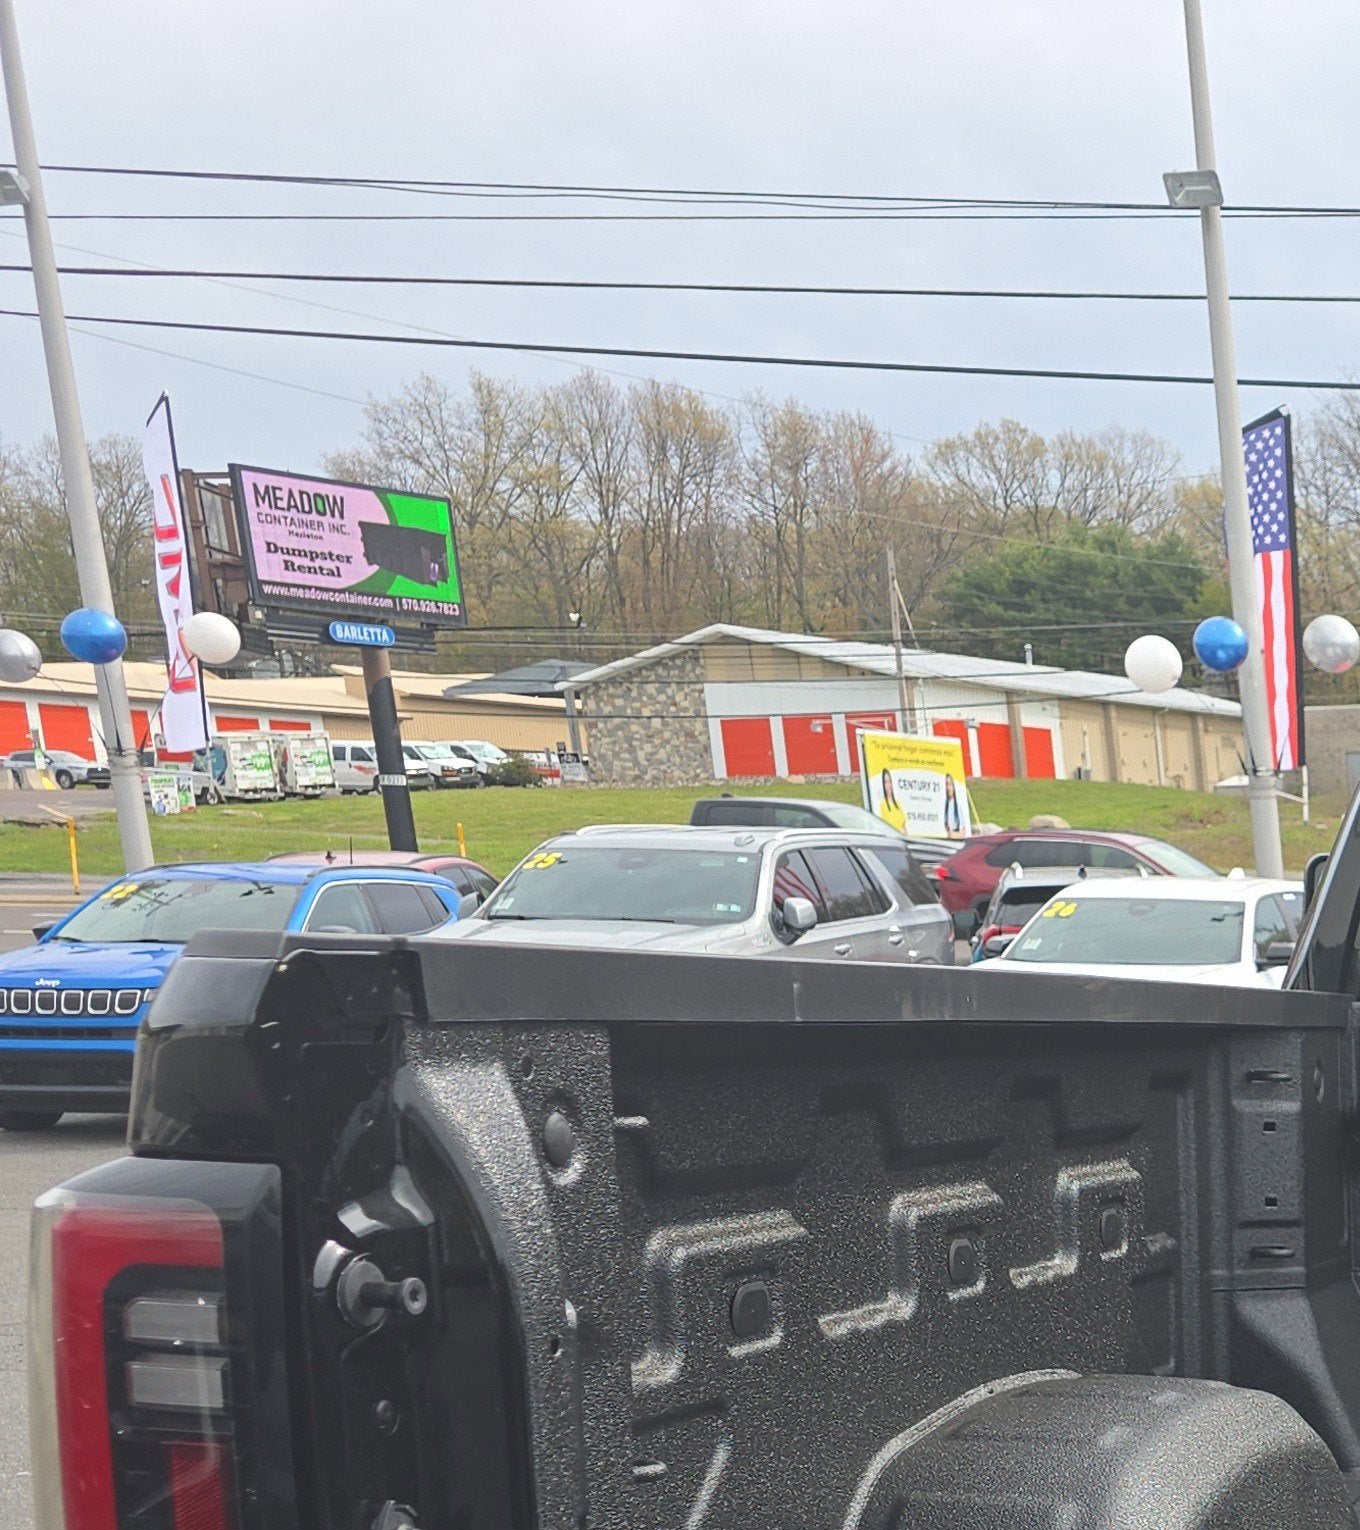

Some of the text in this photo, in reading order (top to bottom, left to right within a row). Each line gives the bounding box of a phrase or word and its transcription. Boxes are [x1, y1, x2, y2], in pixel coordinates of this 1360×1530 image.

[252, 482, 345, 520] MEADOW
[257, 511, 351, 536] CONTAINER INC.
[265, 541, 353, 565] Dumpster
[283, 559, 342, 578] Rental
[262, 583, 393, 609] www.meadowcontainer.com
[335, 623, 390, 643] BARLETTA
[1042, 901, 1077, 918] 26
